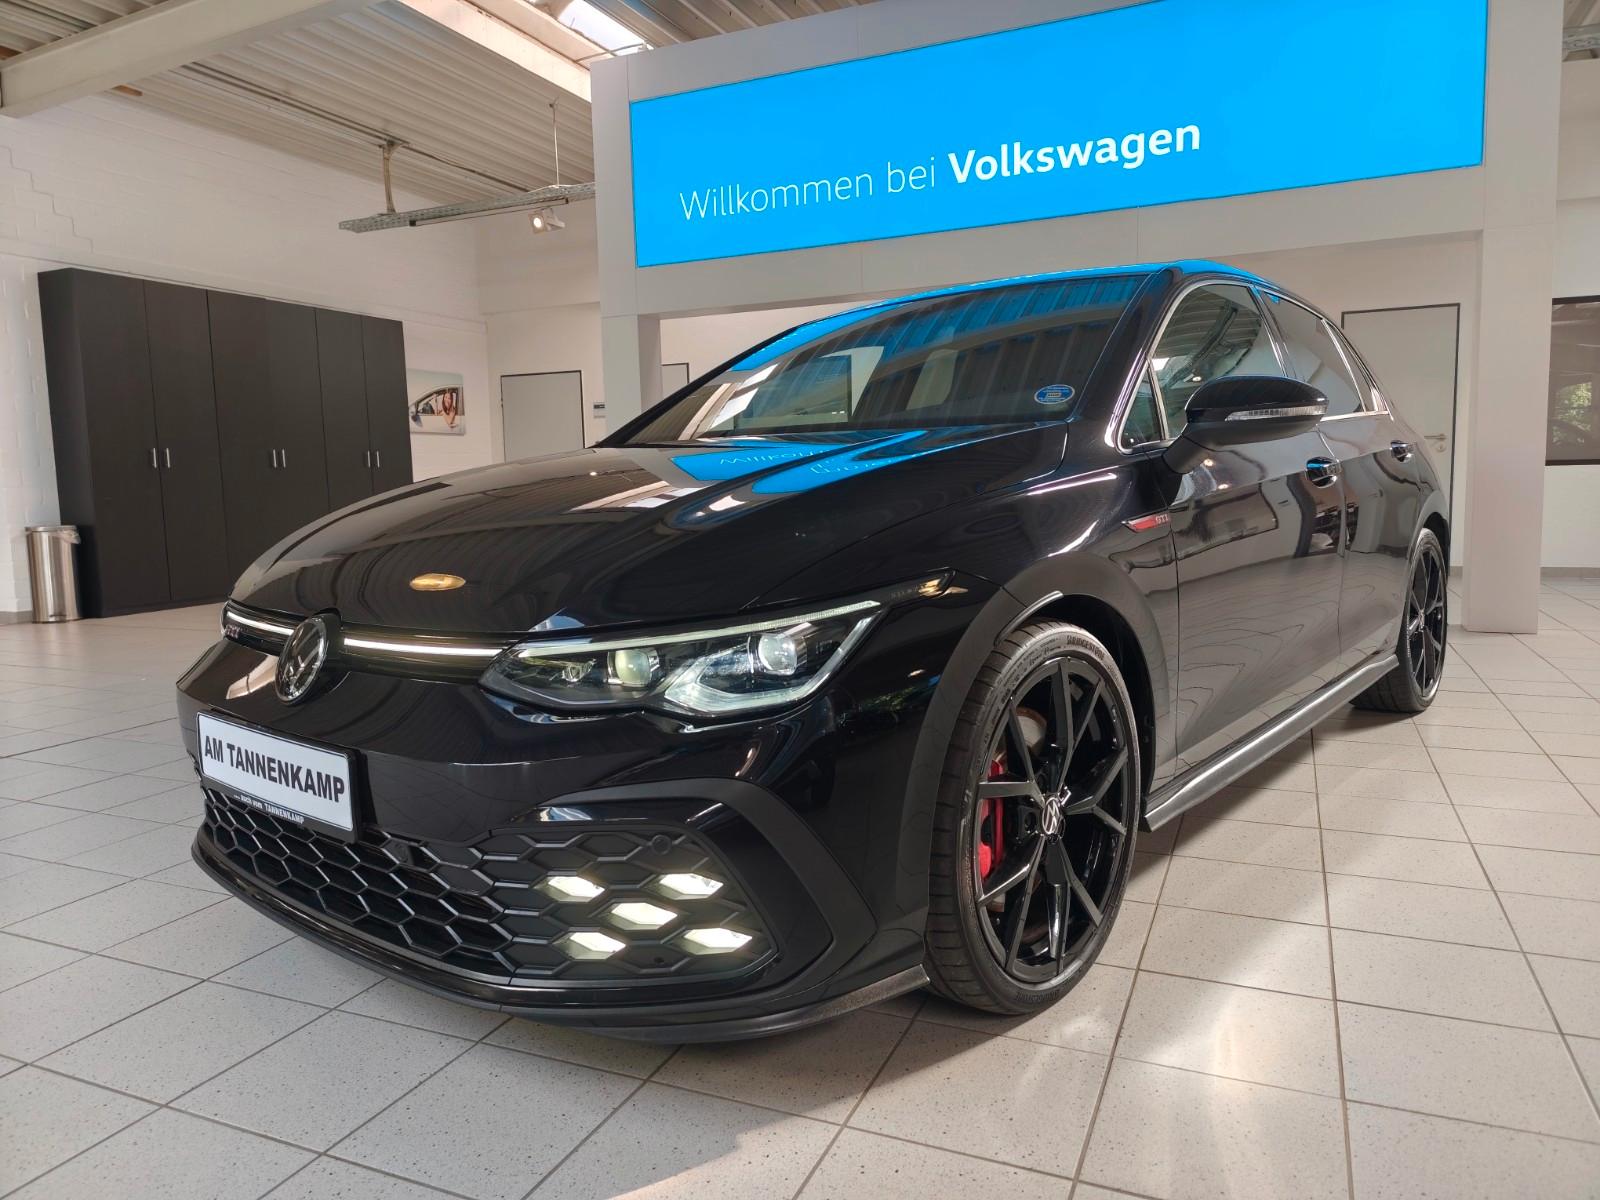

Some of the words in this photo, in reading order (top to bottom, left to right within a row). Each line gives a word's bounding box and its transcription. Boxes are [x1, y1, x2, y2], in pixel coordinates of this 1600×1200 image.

[679, 173, 873, 220] Willkommen
[887, 156, 935, 193] bei
[948, 124, 1201, 184] Volkswagen
[204, 735, 224, 763] AM
[226, 743, 345, 803] TANNENKAMP
[264, 803, 304, 825] TANNENKAMP
